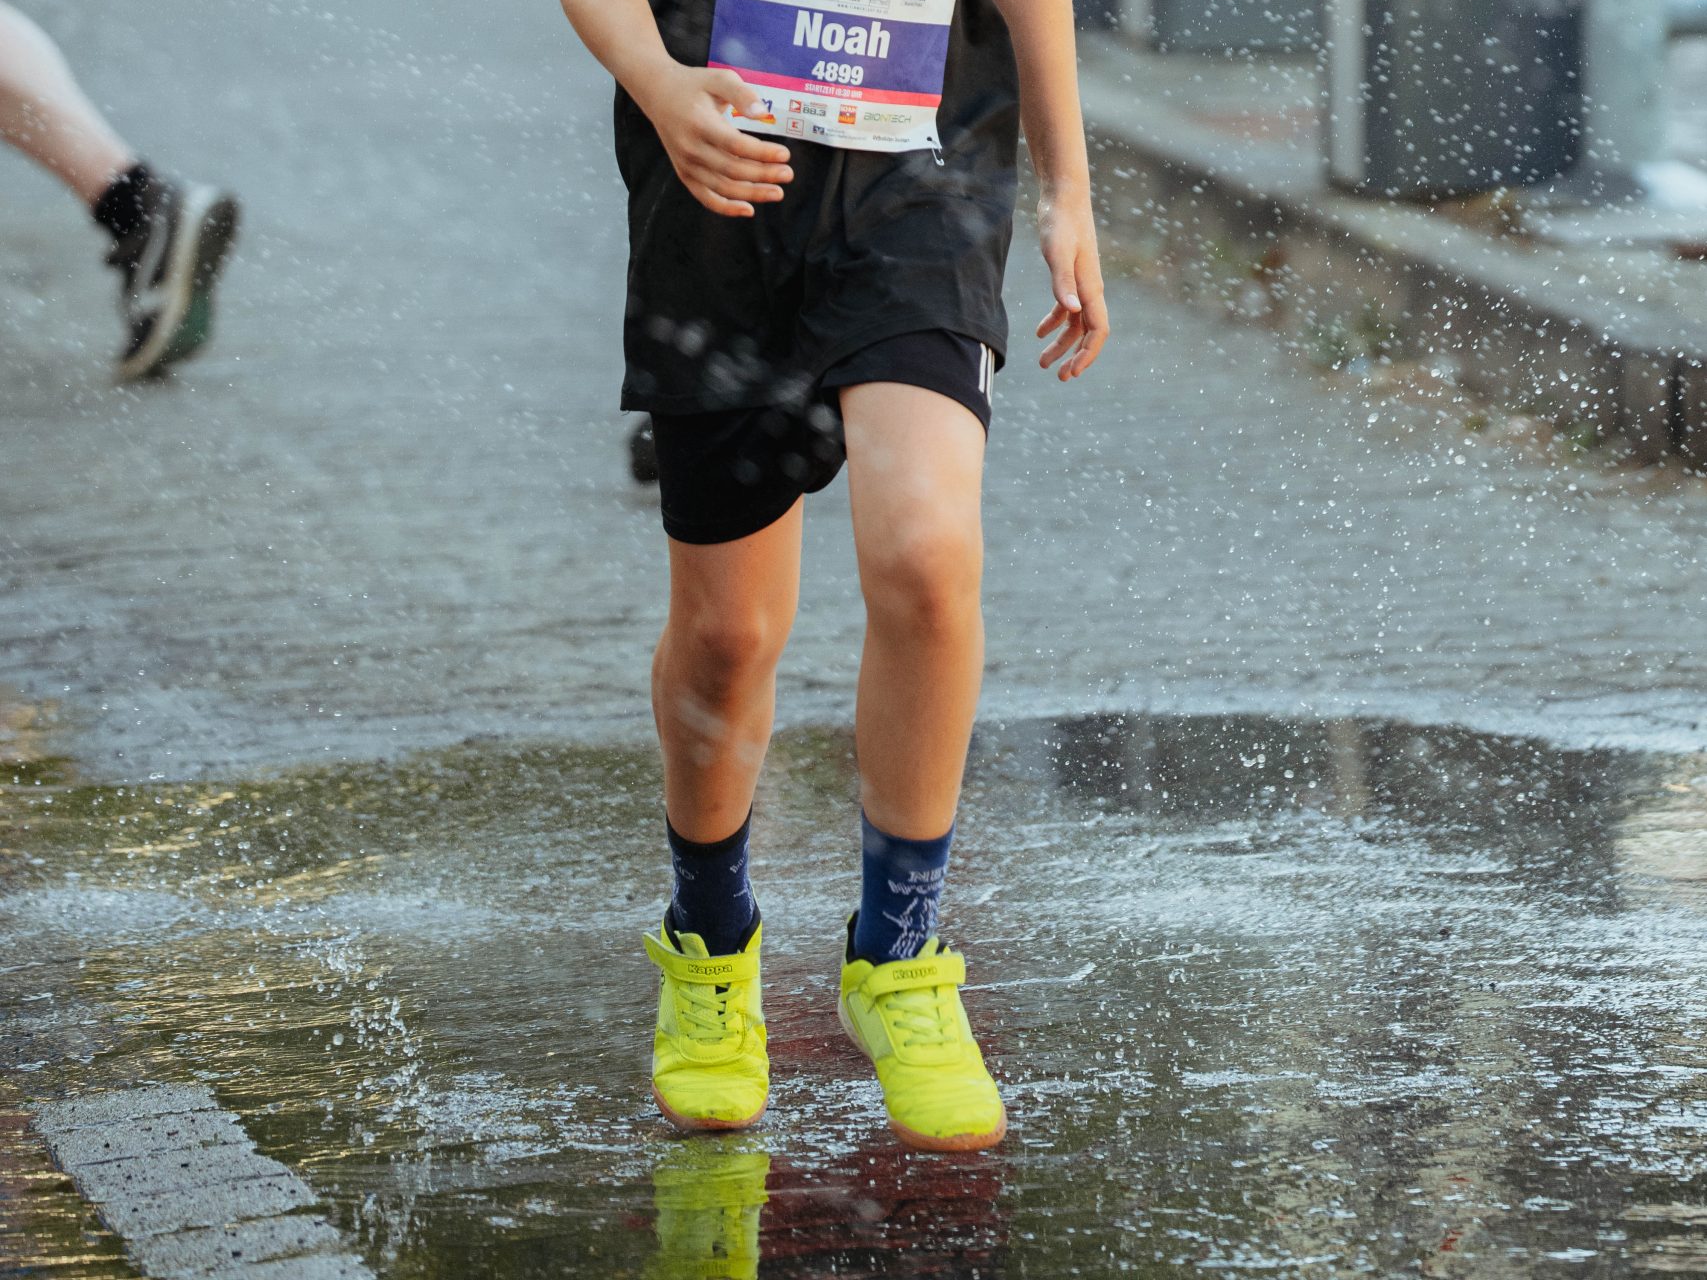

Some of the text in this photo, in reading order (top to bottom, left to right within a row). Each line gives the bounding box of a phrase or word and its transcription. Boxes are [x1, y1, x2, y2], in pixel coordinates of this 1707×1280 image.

[793, 9, 891, 59] Noah
[811, 60, 864, 86] 4899
[802, 106, 827, 117] 88.3
[864, 111, 911, 123] BIONTECH
[687, 964, 732, 975] Kappa
